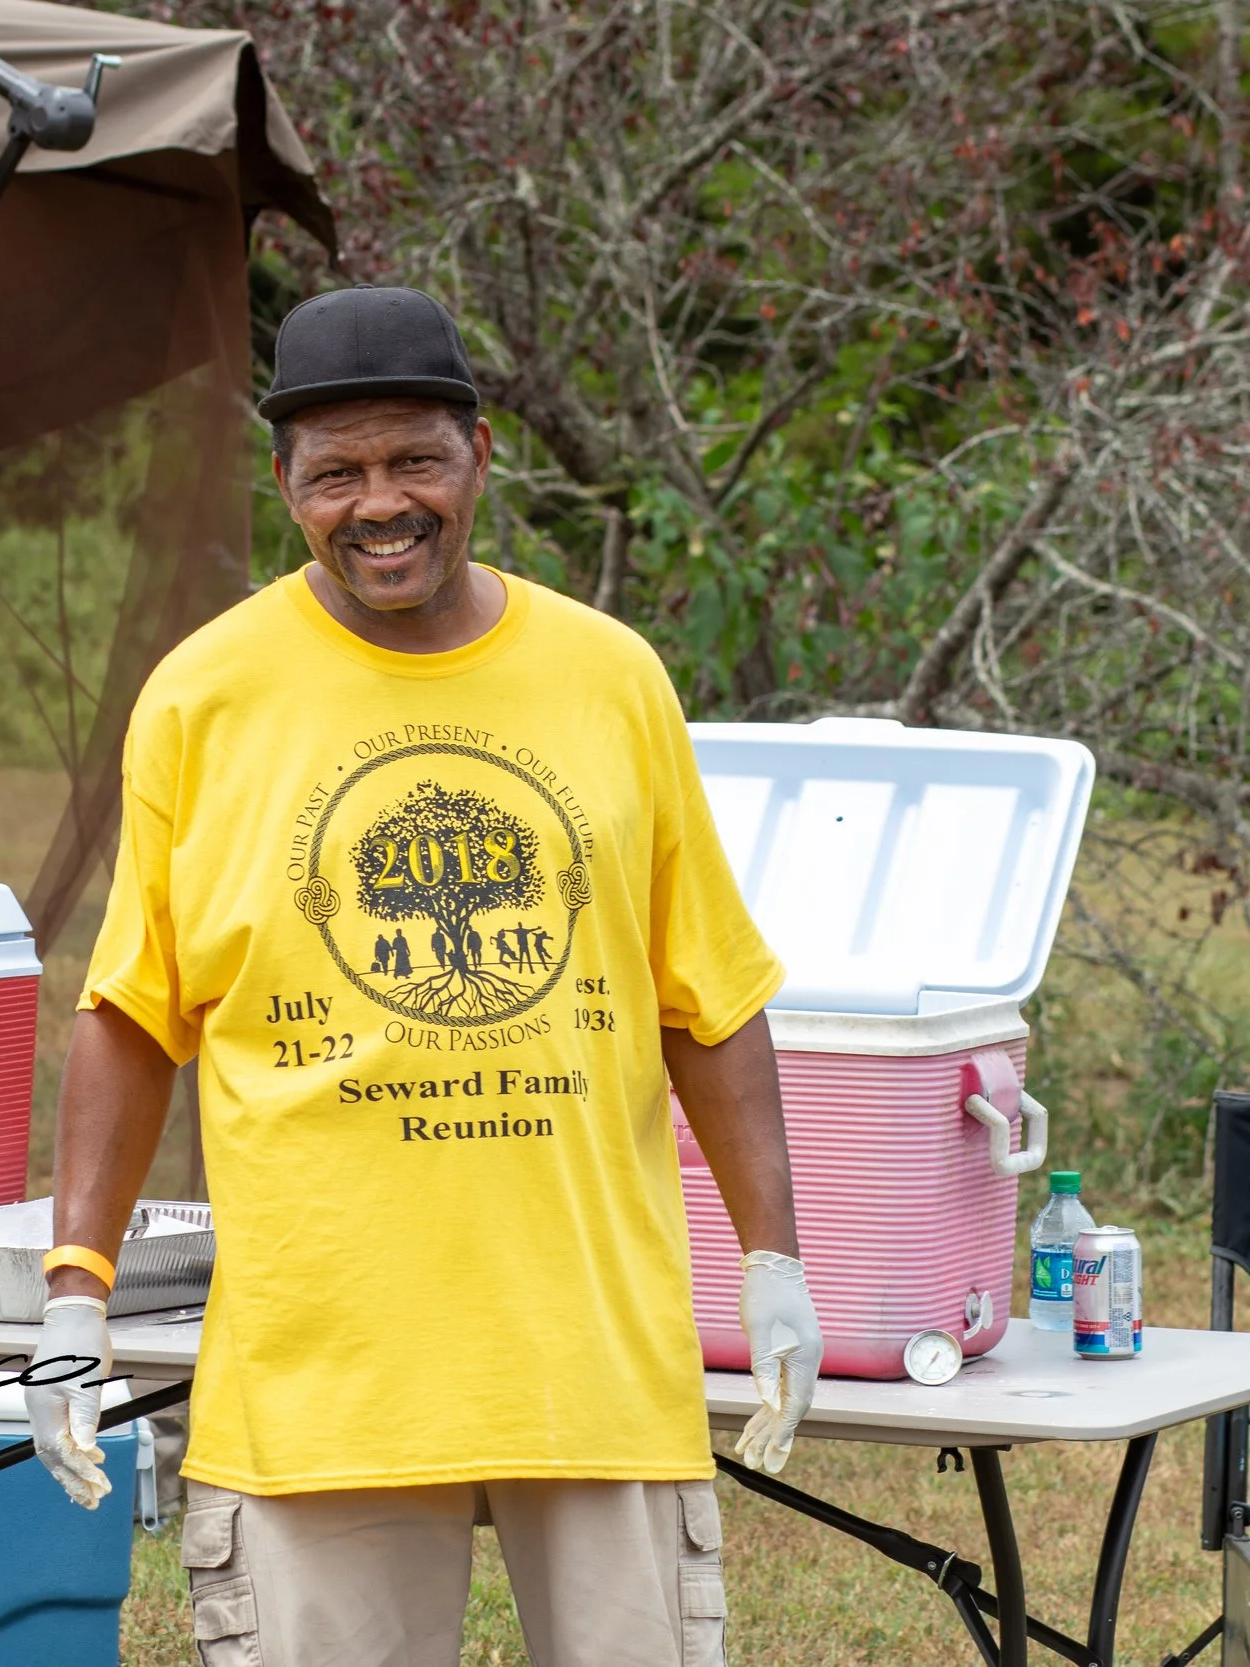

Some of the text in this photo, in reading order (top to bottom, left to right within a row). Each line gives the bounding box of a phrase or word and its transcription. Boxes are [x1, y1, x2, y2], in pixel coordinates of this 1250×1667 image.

[367, 828, 521, 889] 2018
[575, 975, 610, 995] est.
[267, 992, 333, 1026] July
[574, 1007, 617, 1033] 1938
[272, 1032, 355, 1069] 21-22
[339, 1069, 590, 1104] Seward Family
[399, 1112, 554, 1142] Reunion
[1073, 1255, 1108, 1275] ural
